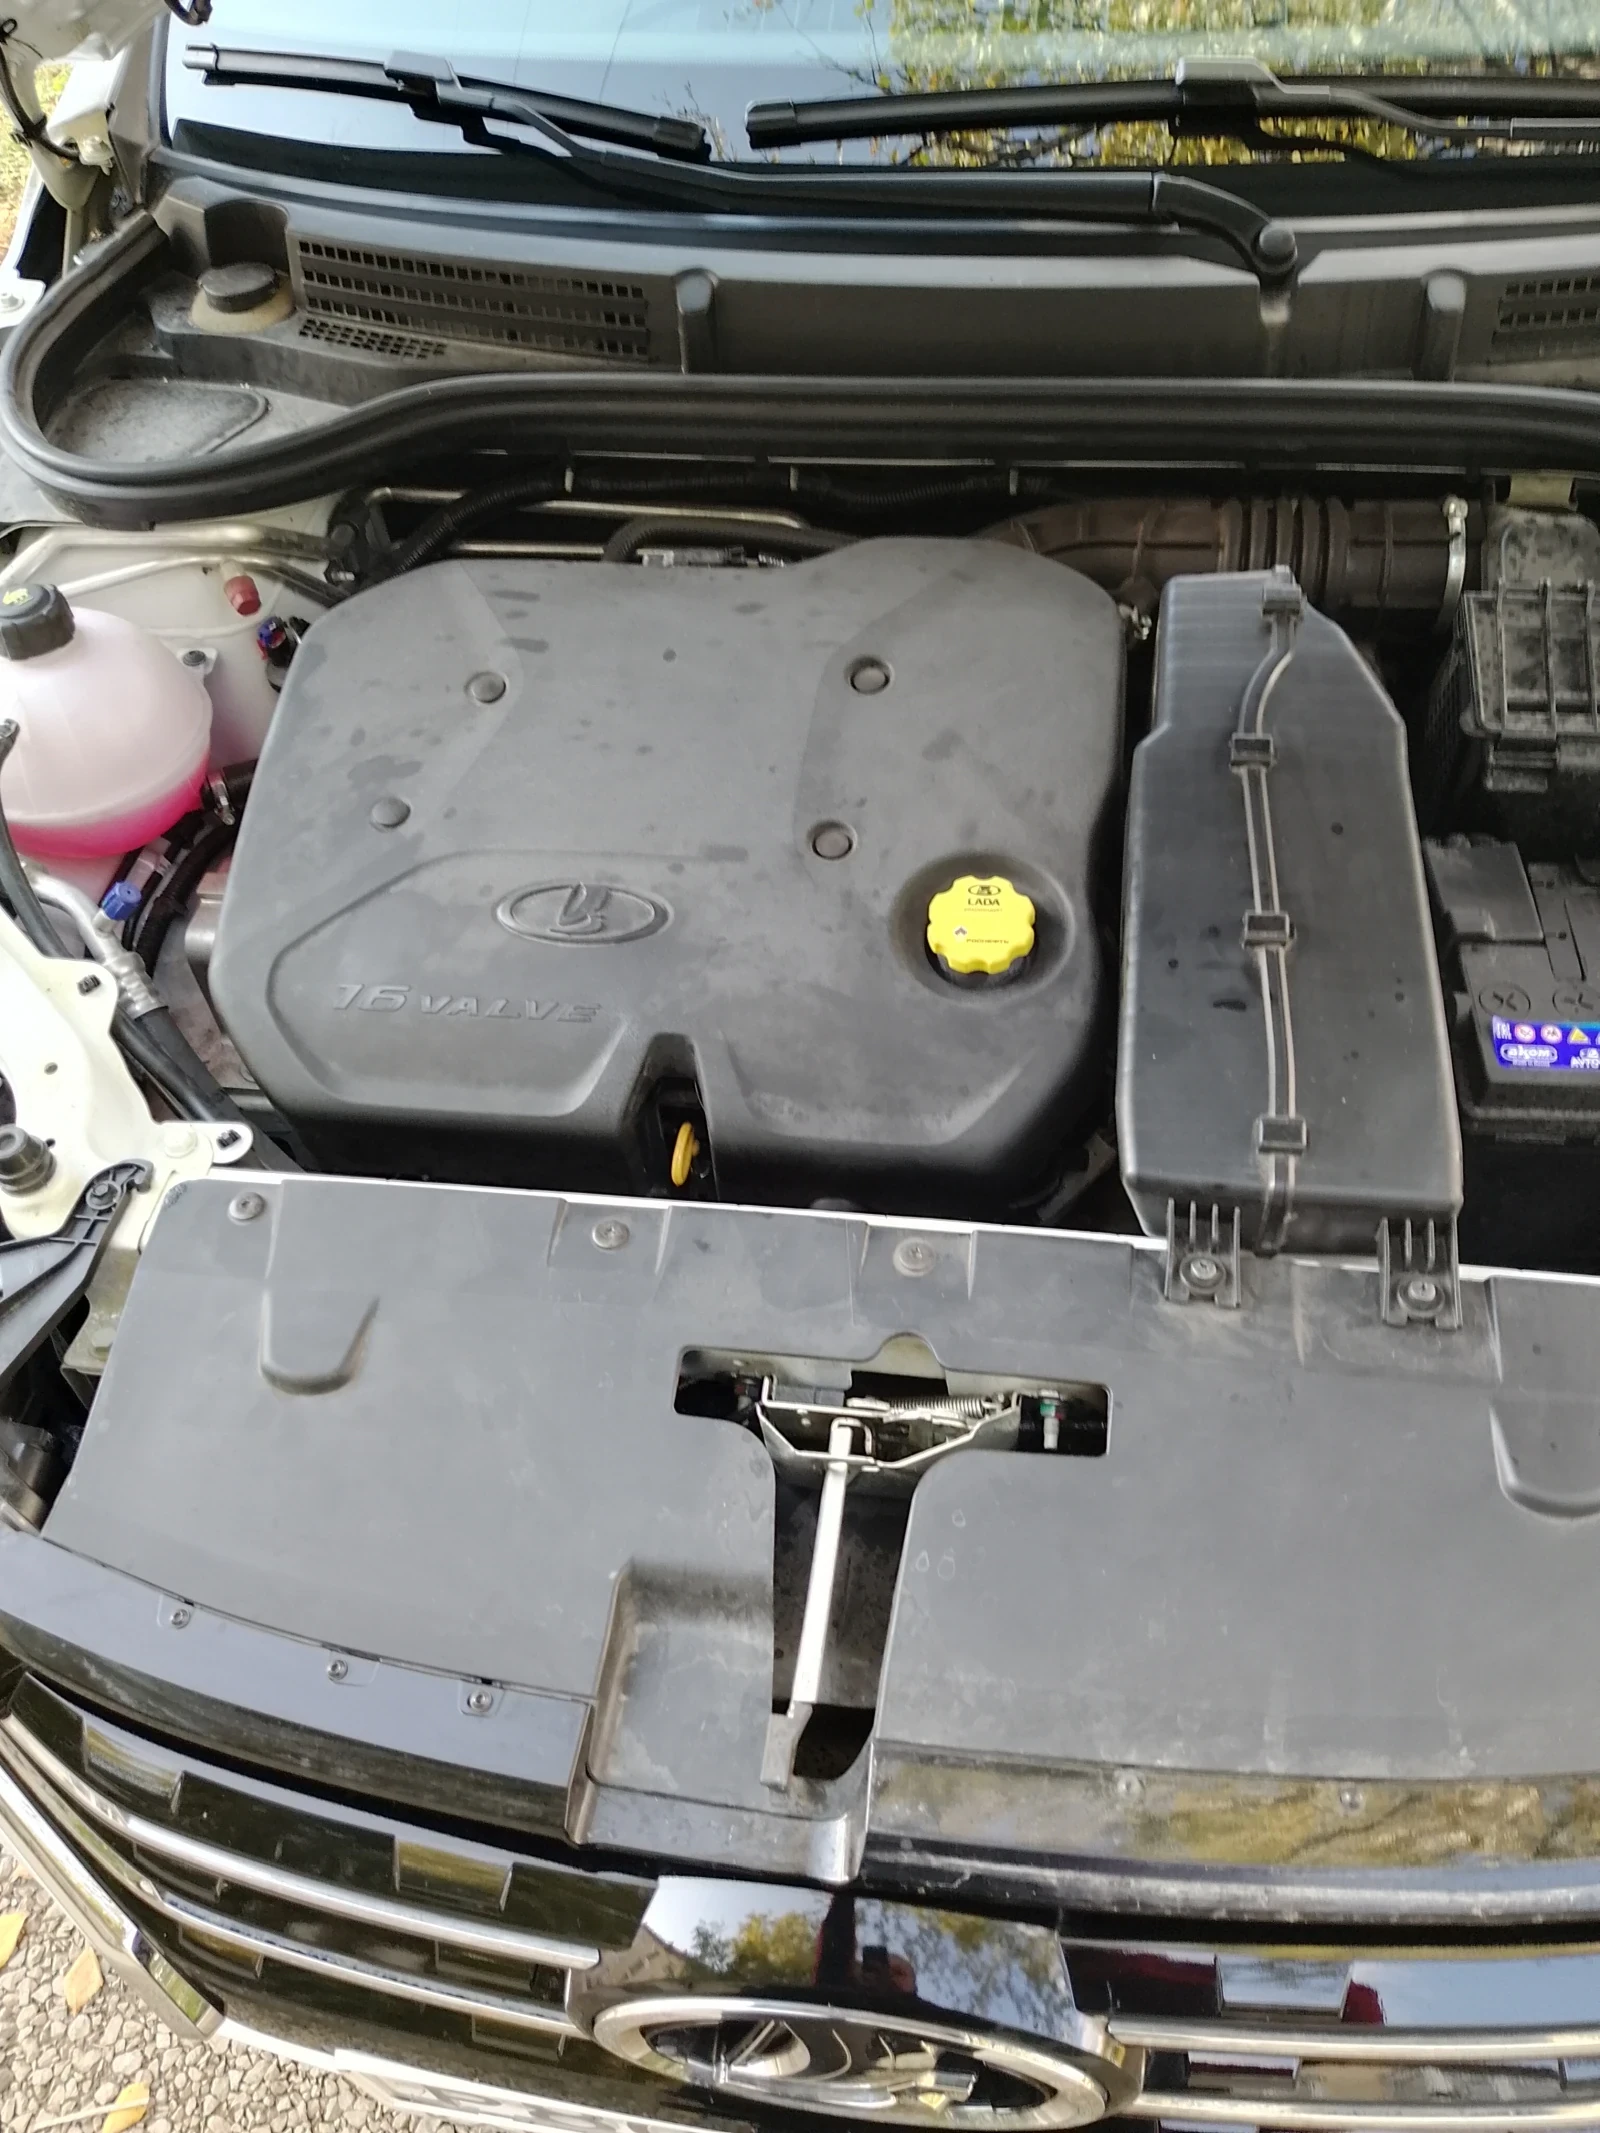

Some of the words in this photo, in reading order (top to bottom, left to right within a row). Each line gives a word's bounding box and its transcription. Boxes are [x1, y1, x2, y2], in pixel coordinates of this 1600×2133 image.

[967, 898, 1000, 906] LADA
[333, 984, 411, 1012] 16
[419, 994, 601, 1022] VALVE
